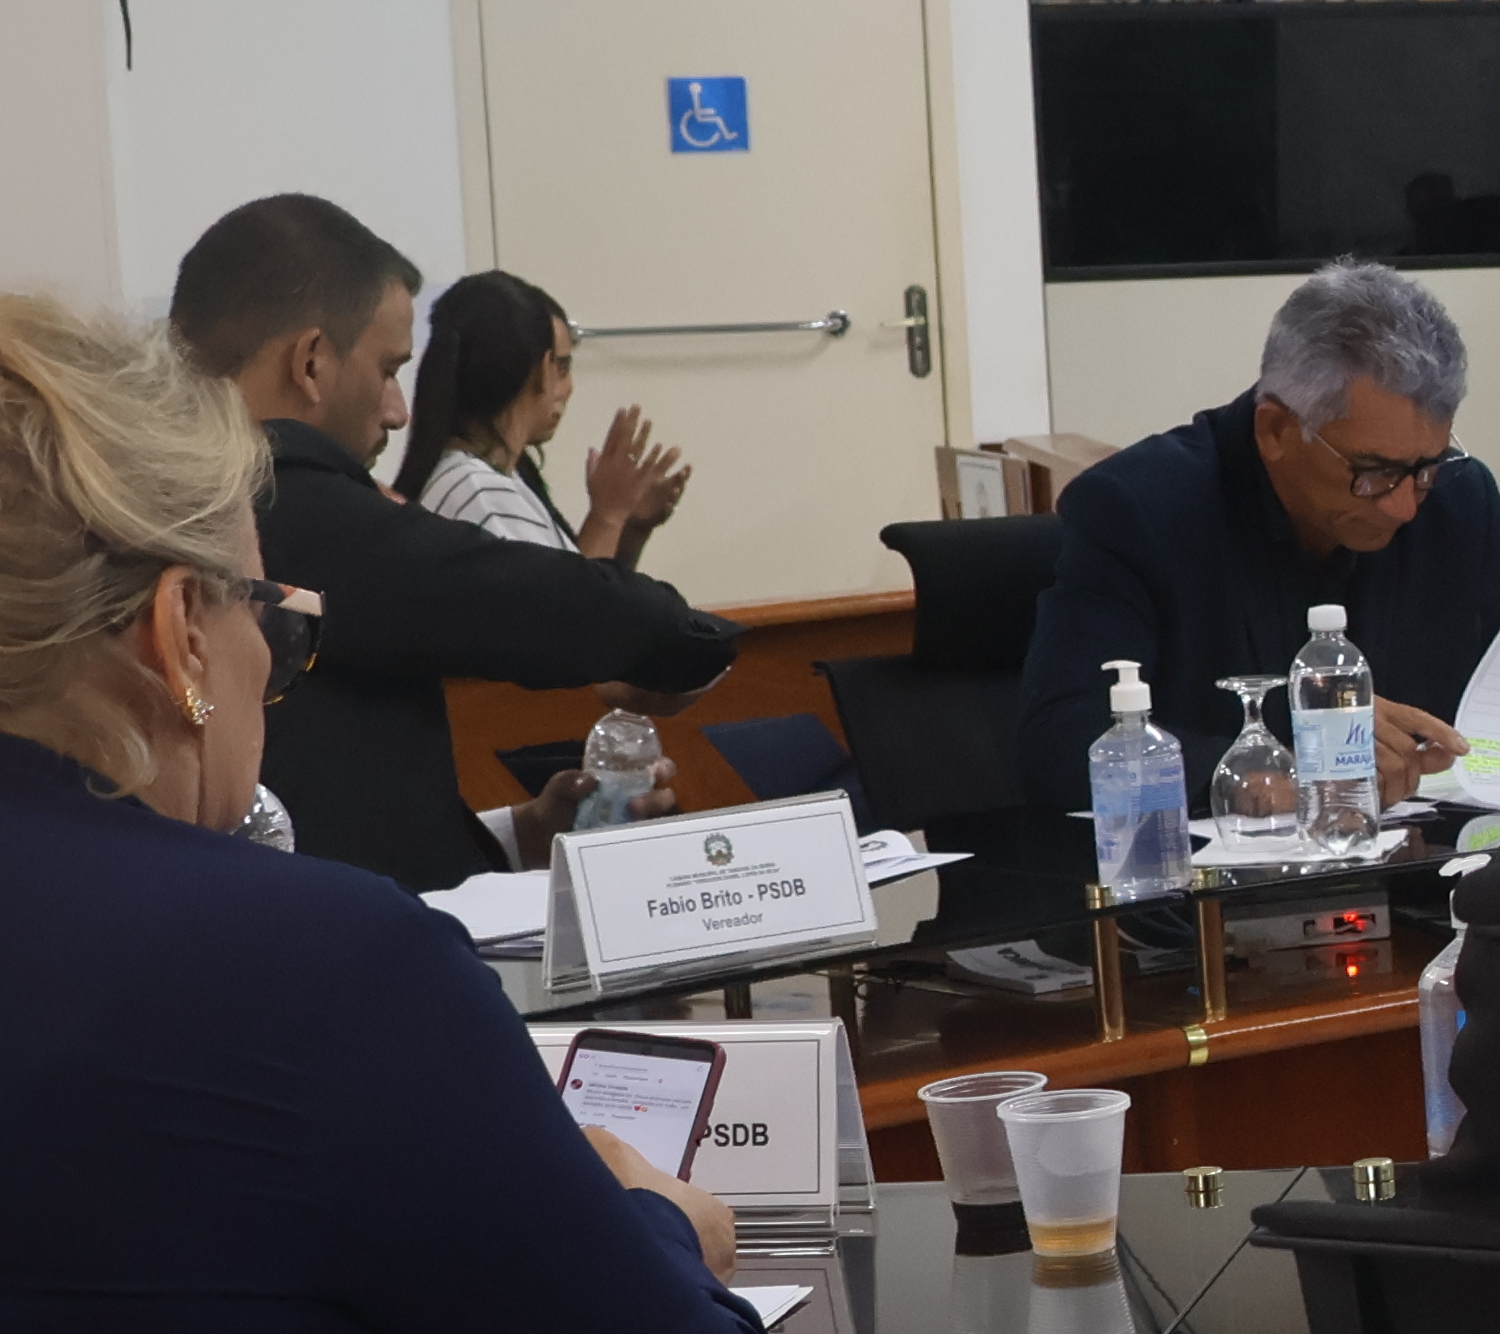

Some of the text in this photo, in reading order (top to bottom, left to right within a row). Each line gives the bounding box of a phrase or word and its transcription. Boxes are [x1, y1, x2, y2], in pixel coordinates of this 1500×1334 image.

[646, 895, 697, 918] Fabio
[700, 889, 743, 910] Brito
[757, 877, 806, 901] PSDB
[701, 911, 764, 932] Vereador
